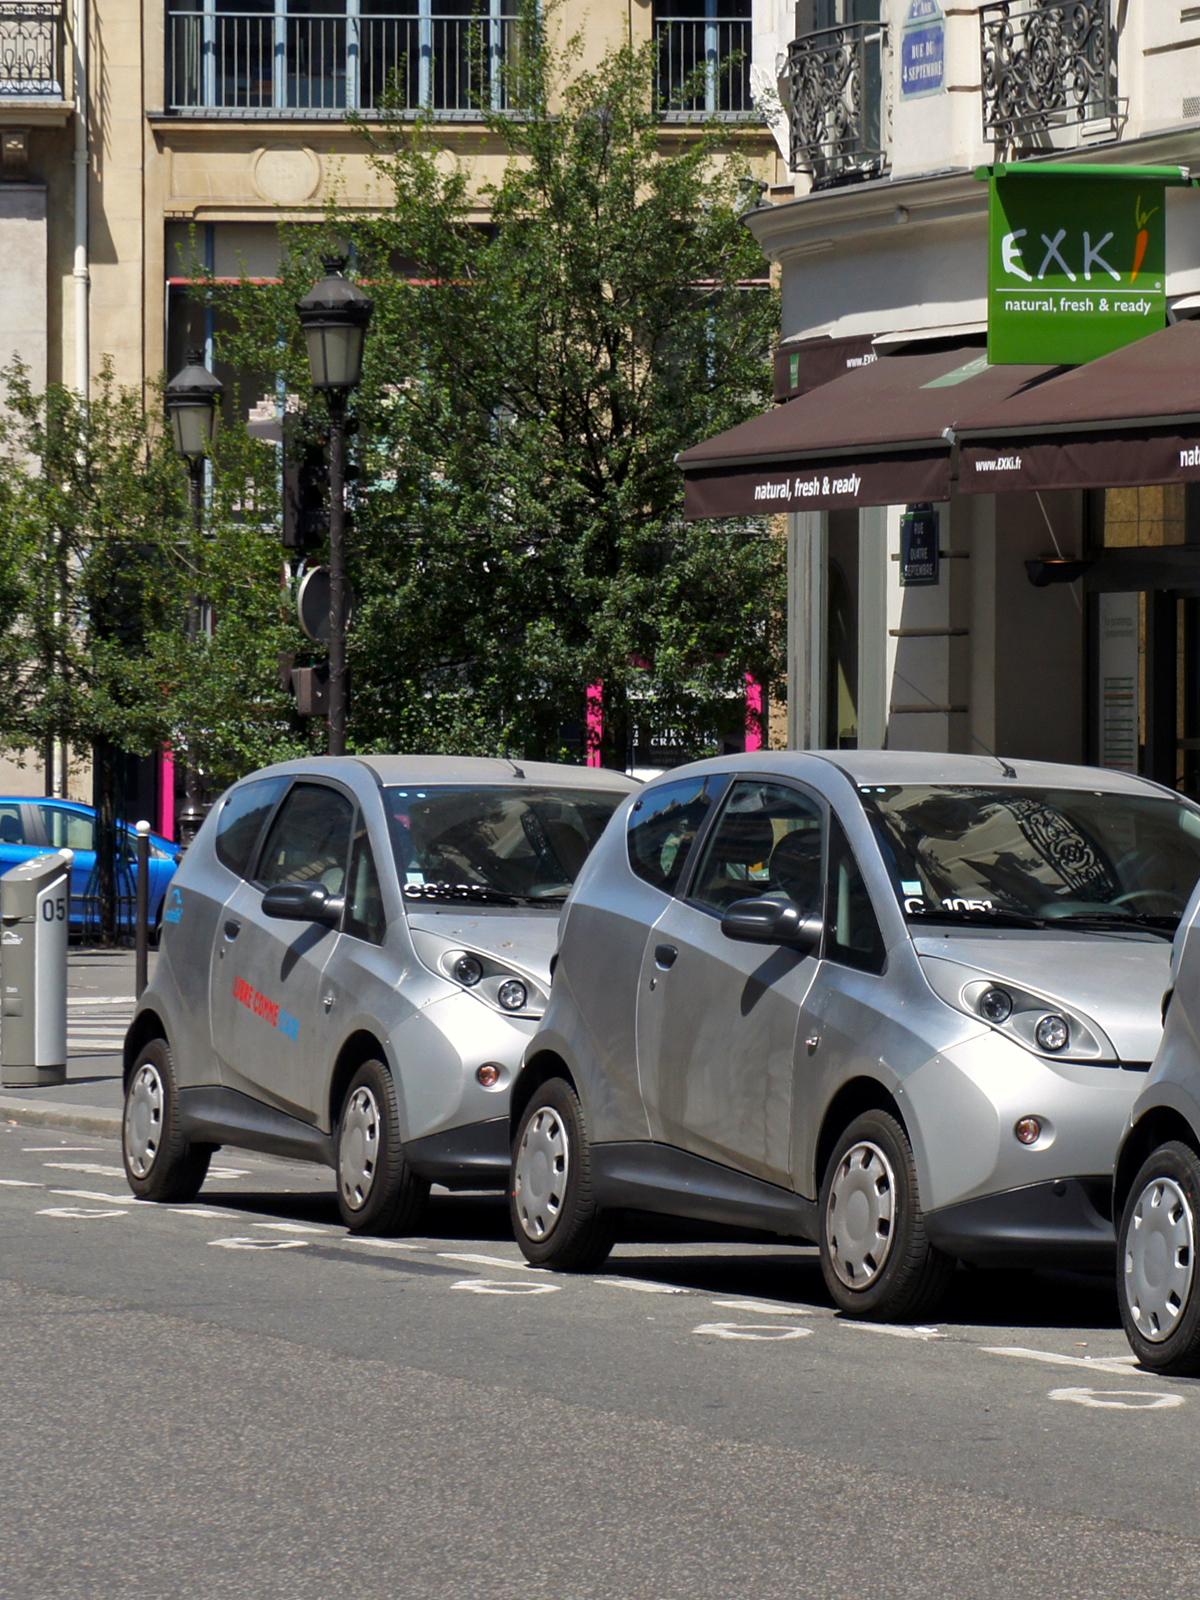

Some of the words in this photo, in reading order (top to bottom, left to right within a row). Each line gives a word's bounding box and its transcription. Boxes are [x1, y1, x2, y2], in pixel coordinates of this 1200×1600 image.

[911, 43, 924, 60] RUE
[903, 65, 908, 83] 4
[908, 60, 943, 81] SEPTEMBRE
[1004, 297, 1058, 313] natural,
[1060, 297, 1094, 312] fresh
[1098, 298, 1110, 312] &
[1114, 298, 1152, 316] ready
[754, 478, 792, 502] natural,
[794, 476, 820, 497] fresh
[821, 475, 831, 495] &
[831, 472, 862, 497] ready
[42, 896, 66, 923] 05
